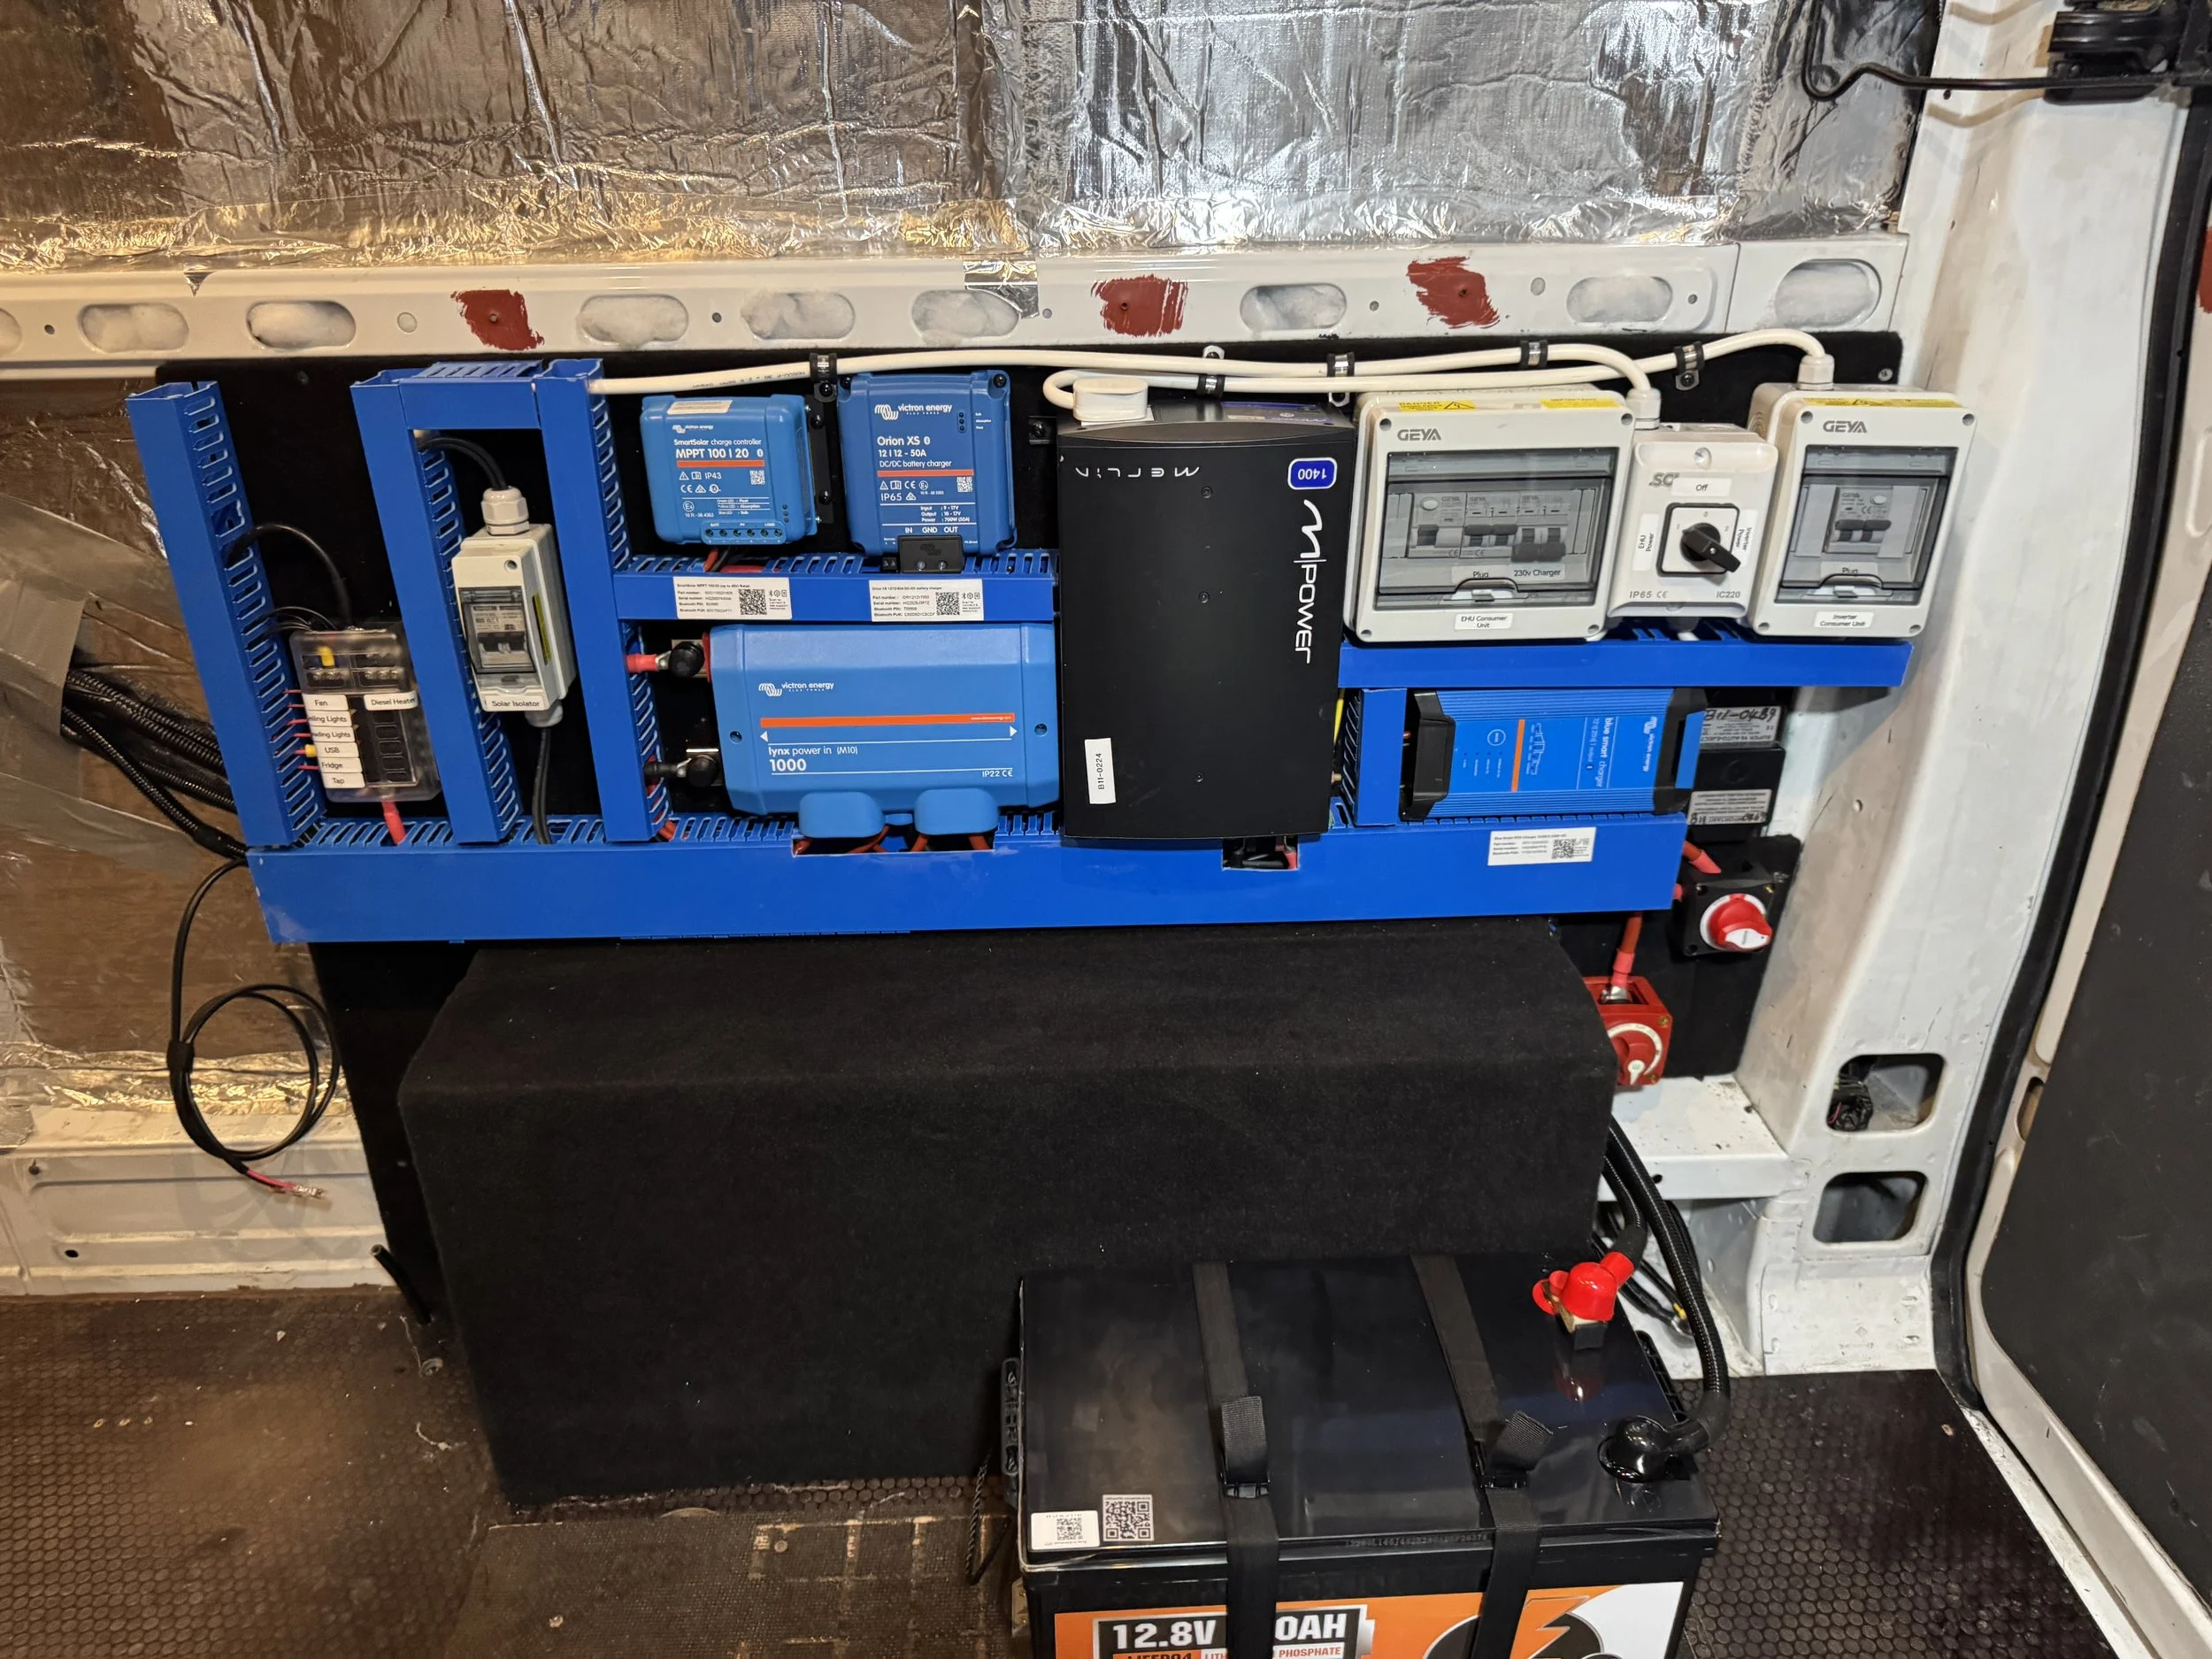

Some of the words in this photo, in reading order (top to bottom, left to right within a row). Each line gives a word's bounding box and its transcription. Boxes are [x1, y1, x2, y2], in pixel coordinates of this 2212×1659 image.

[897, 403, 925, 412] victron
[926, 403, 953, 413] energy
[1823, 419, 1868, 434] GEYA
[876, 435, 904, 446] Orion
[906, 436, 920, 446] XS
[1396, 428, 1442, 442] GEYA
[675, 449, 705, 459] MPPT
[708, 449, 726, 458] 100
[735, 448, 749, 458] 20
[910, 449, 927, 457] 50A
[902, 460, 926, 469] battery
[926, 459, 952, 468] charger
[704, 472, 722, 480] IP43
[1296, 468, 1328, 480] 1400
[880, 493, 902, 502] IP65
[1638, 534, 1647, 549] EHU
[1646, 533, 1655, 552] Power
[1735, 528, 1745, 548] Power
[1742, 526, 1753, 551] Inverter
[1532, 569, 1562, 578] Charger
[1716, 590, 1741, 599] IC220
[781, 681, 808, 690] victron
[808, 681, 834, 690] energy
[1603, 717, 1614, 734] blue
[768, 747, 790, 757] lynx
[792, 746, 821, 757] power
[823, 745, 832, 755] in
[836, 746, 858, 755] (M10)
[1600, 735, 1609, 758] smart
[769, 757, 808, 772] 1000
[1642, 753, 1652, 772] energy
[1095, 753, 1105, 790] B11-0224
[1594, 760, 1608, 787] charger
[1112, 1619, 1217, 1650] 12.8V
[1279, 1646, 1342, 1658] PHOSPHATE
